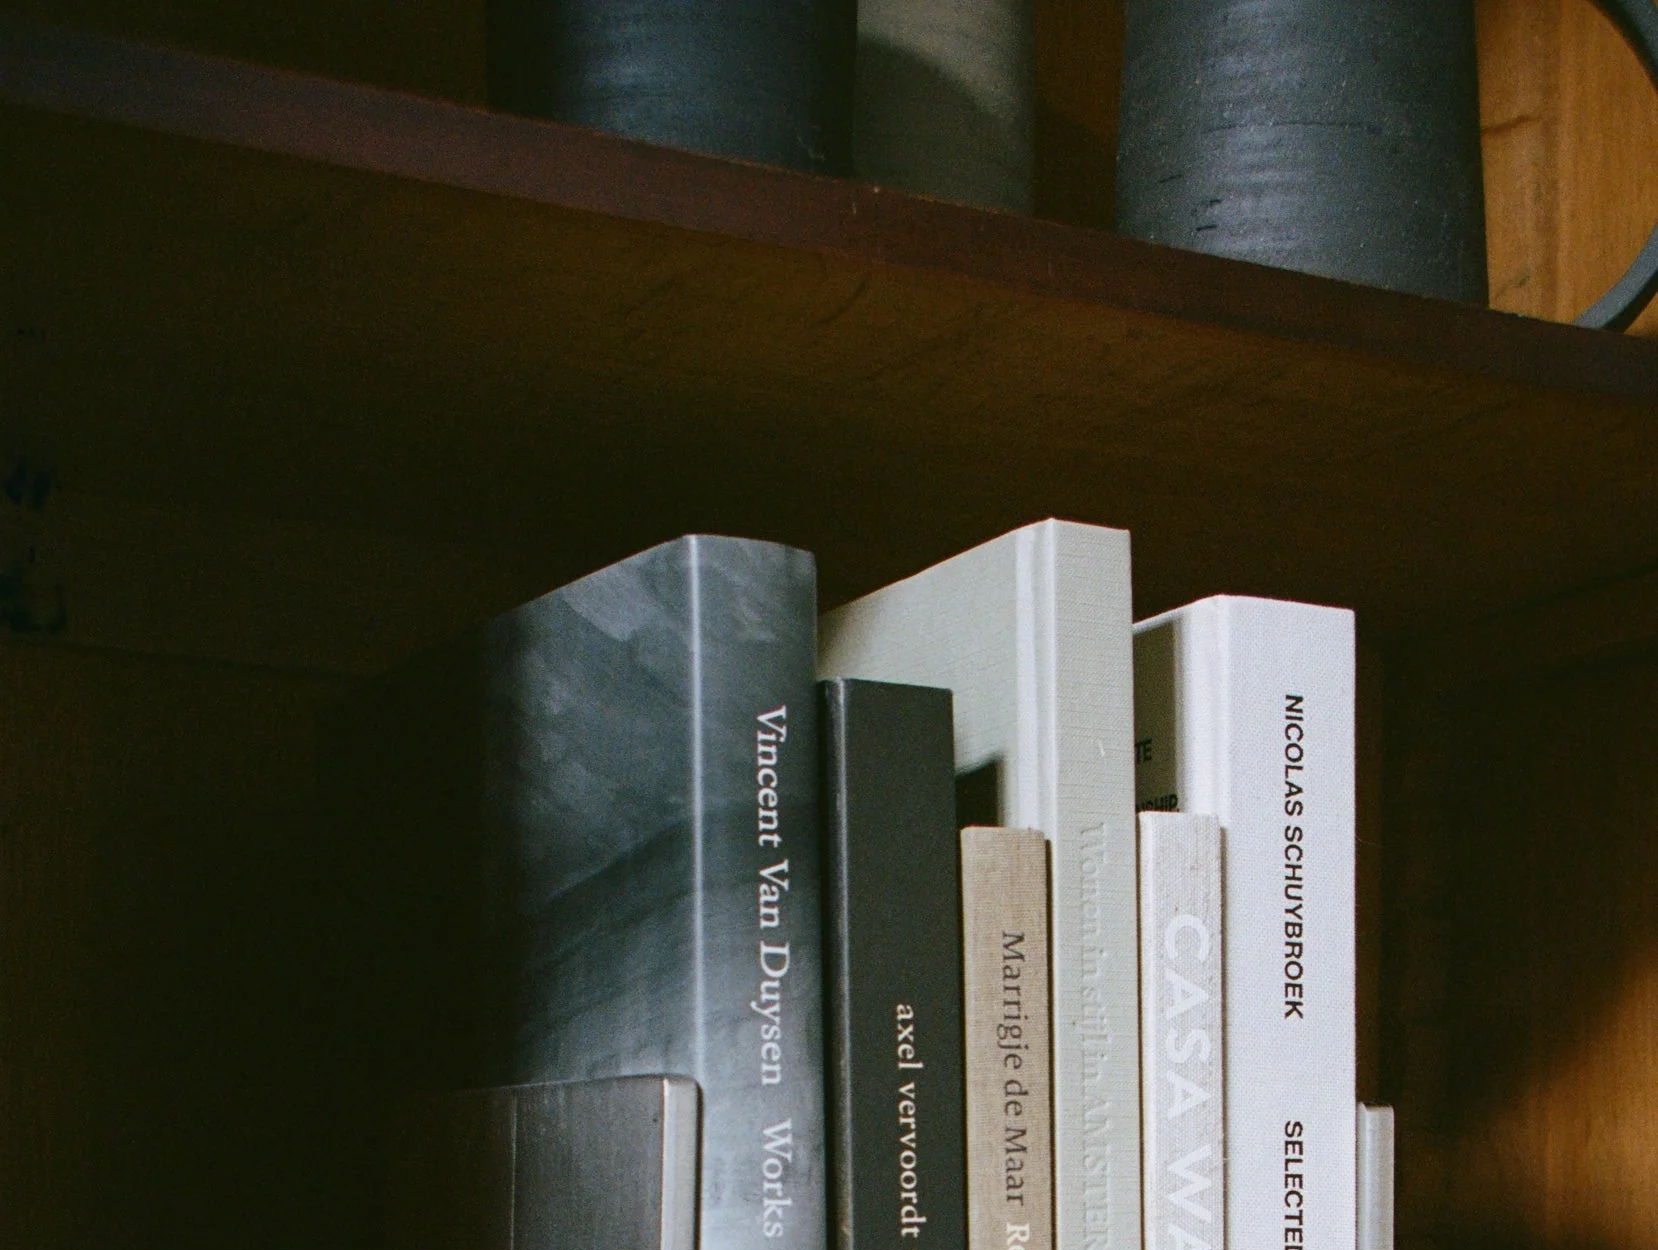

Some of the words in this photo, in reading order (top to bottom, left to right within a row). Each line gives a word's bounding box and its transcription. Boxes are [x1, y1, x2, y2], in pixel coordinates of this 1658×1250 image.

[756, 705, 787, 848] Vincent
[1284, 694, 1305, 817] NICOLAS
[759, 858, 790, 929] Van
[1080, 820, 1108, 936] Wonen
[1283, 824, 1304, 1019] SCHUYBROEK
[751, 941, 790, 1084] Duysen
[996, 931, 1030, 1070] Marrigje
[1080, 943, 1108, 980] in
[1164, 914, 1212, 1119] CASA
[897, 1003, 924, 1069] axel
[1081, 1050, 1109, 1086] in
[1003, 1078, 1030, 1117] de
[761, 1119, 792, 1239] Works
[898, 1081, 927, 1238] vervoordt
[1004, 1126, 1028, 1207] Maar
